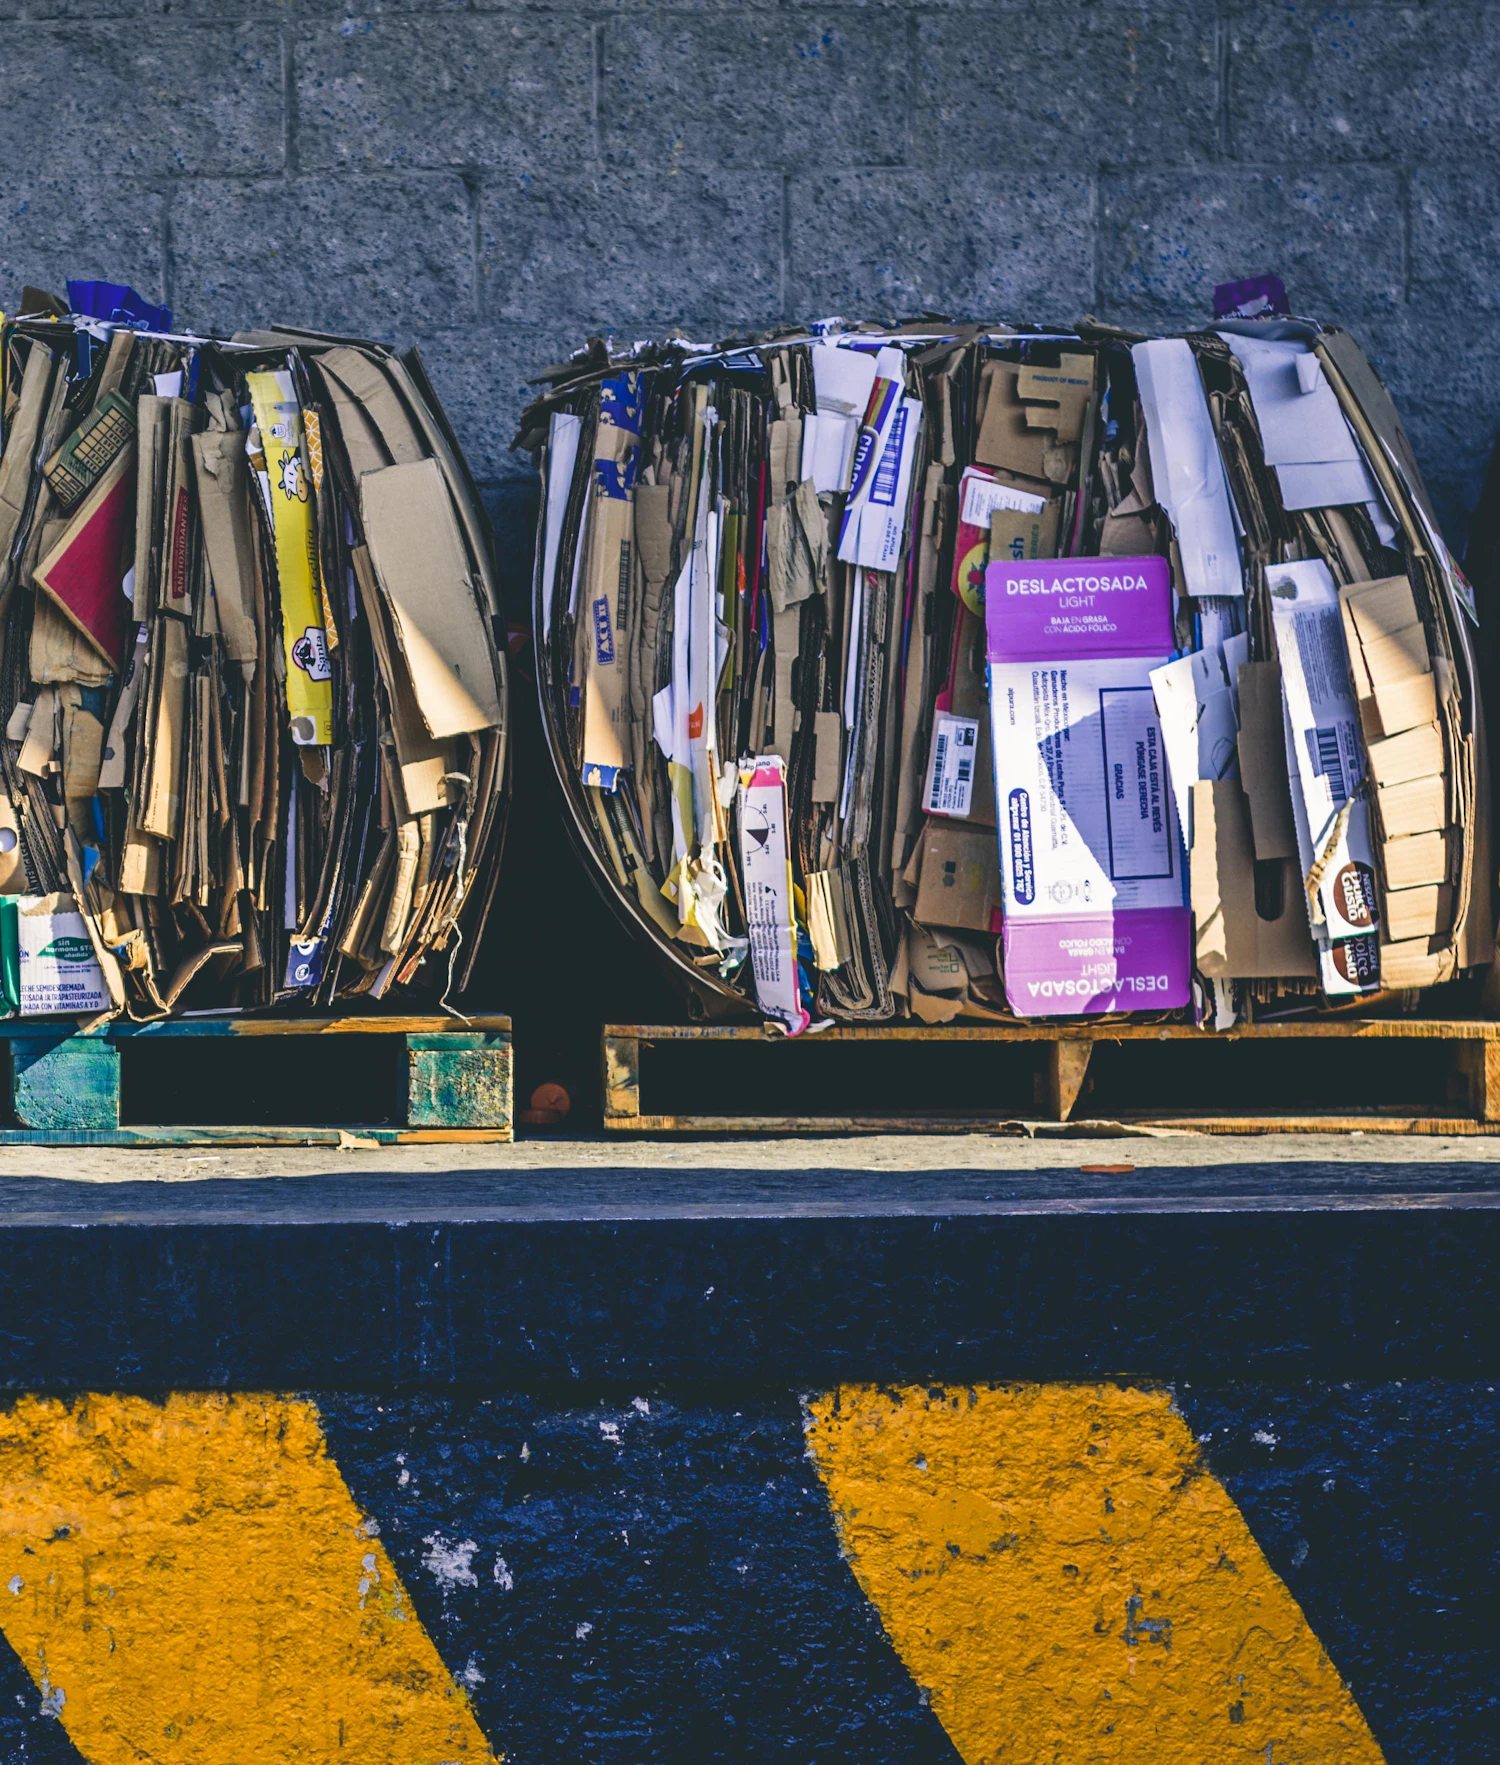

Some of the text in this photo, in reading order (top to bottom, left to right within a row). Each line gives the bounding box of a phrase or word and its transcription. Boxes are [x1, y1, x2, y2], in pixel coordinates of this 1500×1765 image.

[1006, 575, 1148, 595] DESLACTOSADA
[1060, 595, 1095, 608] LIGHT
[1051, 616, 1070, 625] BAJA
[1082, 615, 1108, 623] GRASA
[1044, 622, 1117, 634] CON ÁCIDO FÓLICO
[316, 635, 328, 673] Santa
[1060, 669, 1068, 691] Hecho
[1051, 670, 1059, 706] Ganaderos
[1061, 692, 1066, 701] en
[1008, 687, 1016, 726] alpura.com
[1147, 726, 1157, 748] ESTA
[1148, 748, 1158, 771] CAJA
[1114, 763, 1125, 799] GRACIAS
[1136, 741, 1149, 820] PÓNGASE DERECHA
[1151, 793, 1159, 805] AL
[1152, 805, 1163, 833] REVÉS
[1362, 873, 1377, 911] NESCAFÉ
[58, 938, 70, 946] sin
[1113, 936, 1133, 946] CON
[46, 946, 78, 954] hormona
[63, 951, 88, 959] añadida
[1068, 946, 1094, 957] GRASA
[1080, 962, 1117, 976] LIGHT
[36, 983, 85, 992] SEMIDESCREMADA
[1027, 975, 1169, 998] DESLACTOSADA
[45, 992, 102, 1002] ULTRAPASTEURIZADA
[41, 1002, 52, 1010] CON
[52, 1001, 83, 1010] VITAMINAS
[95, 1000, 100, 1008] D
